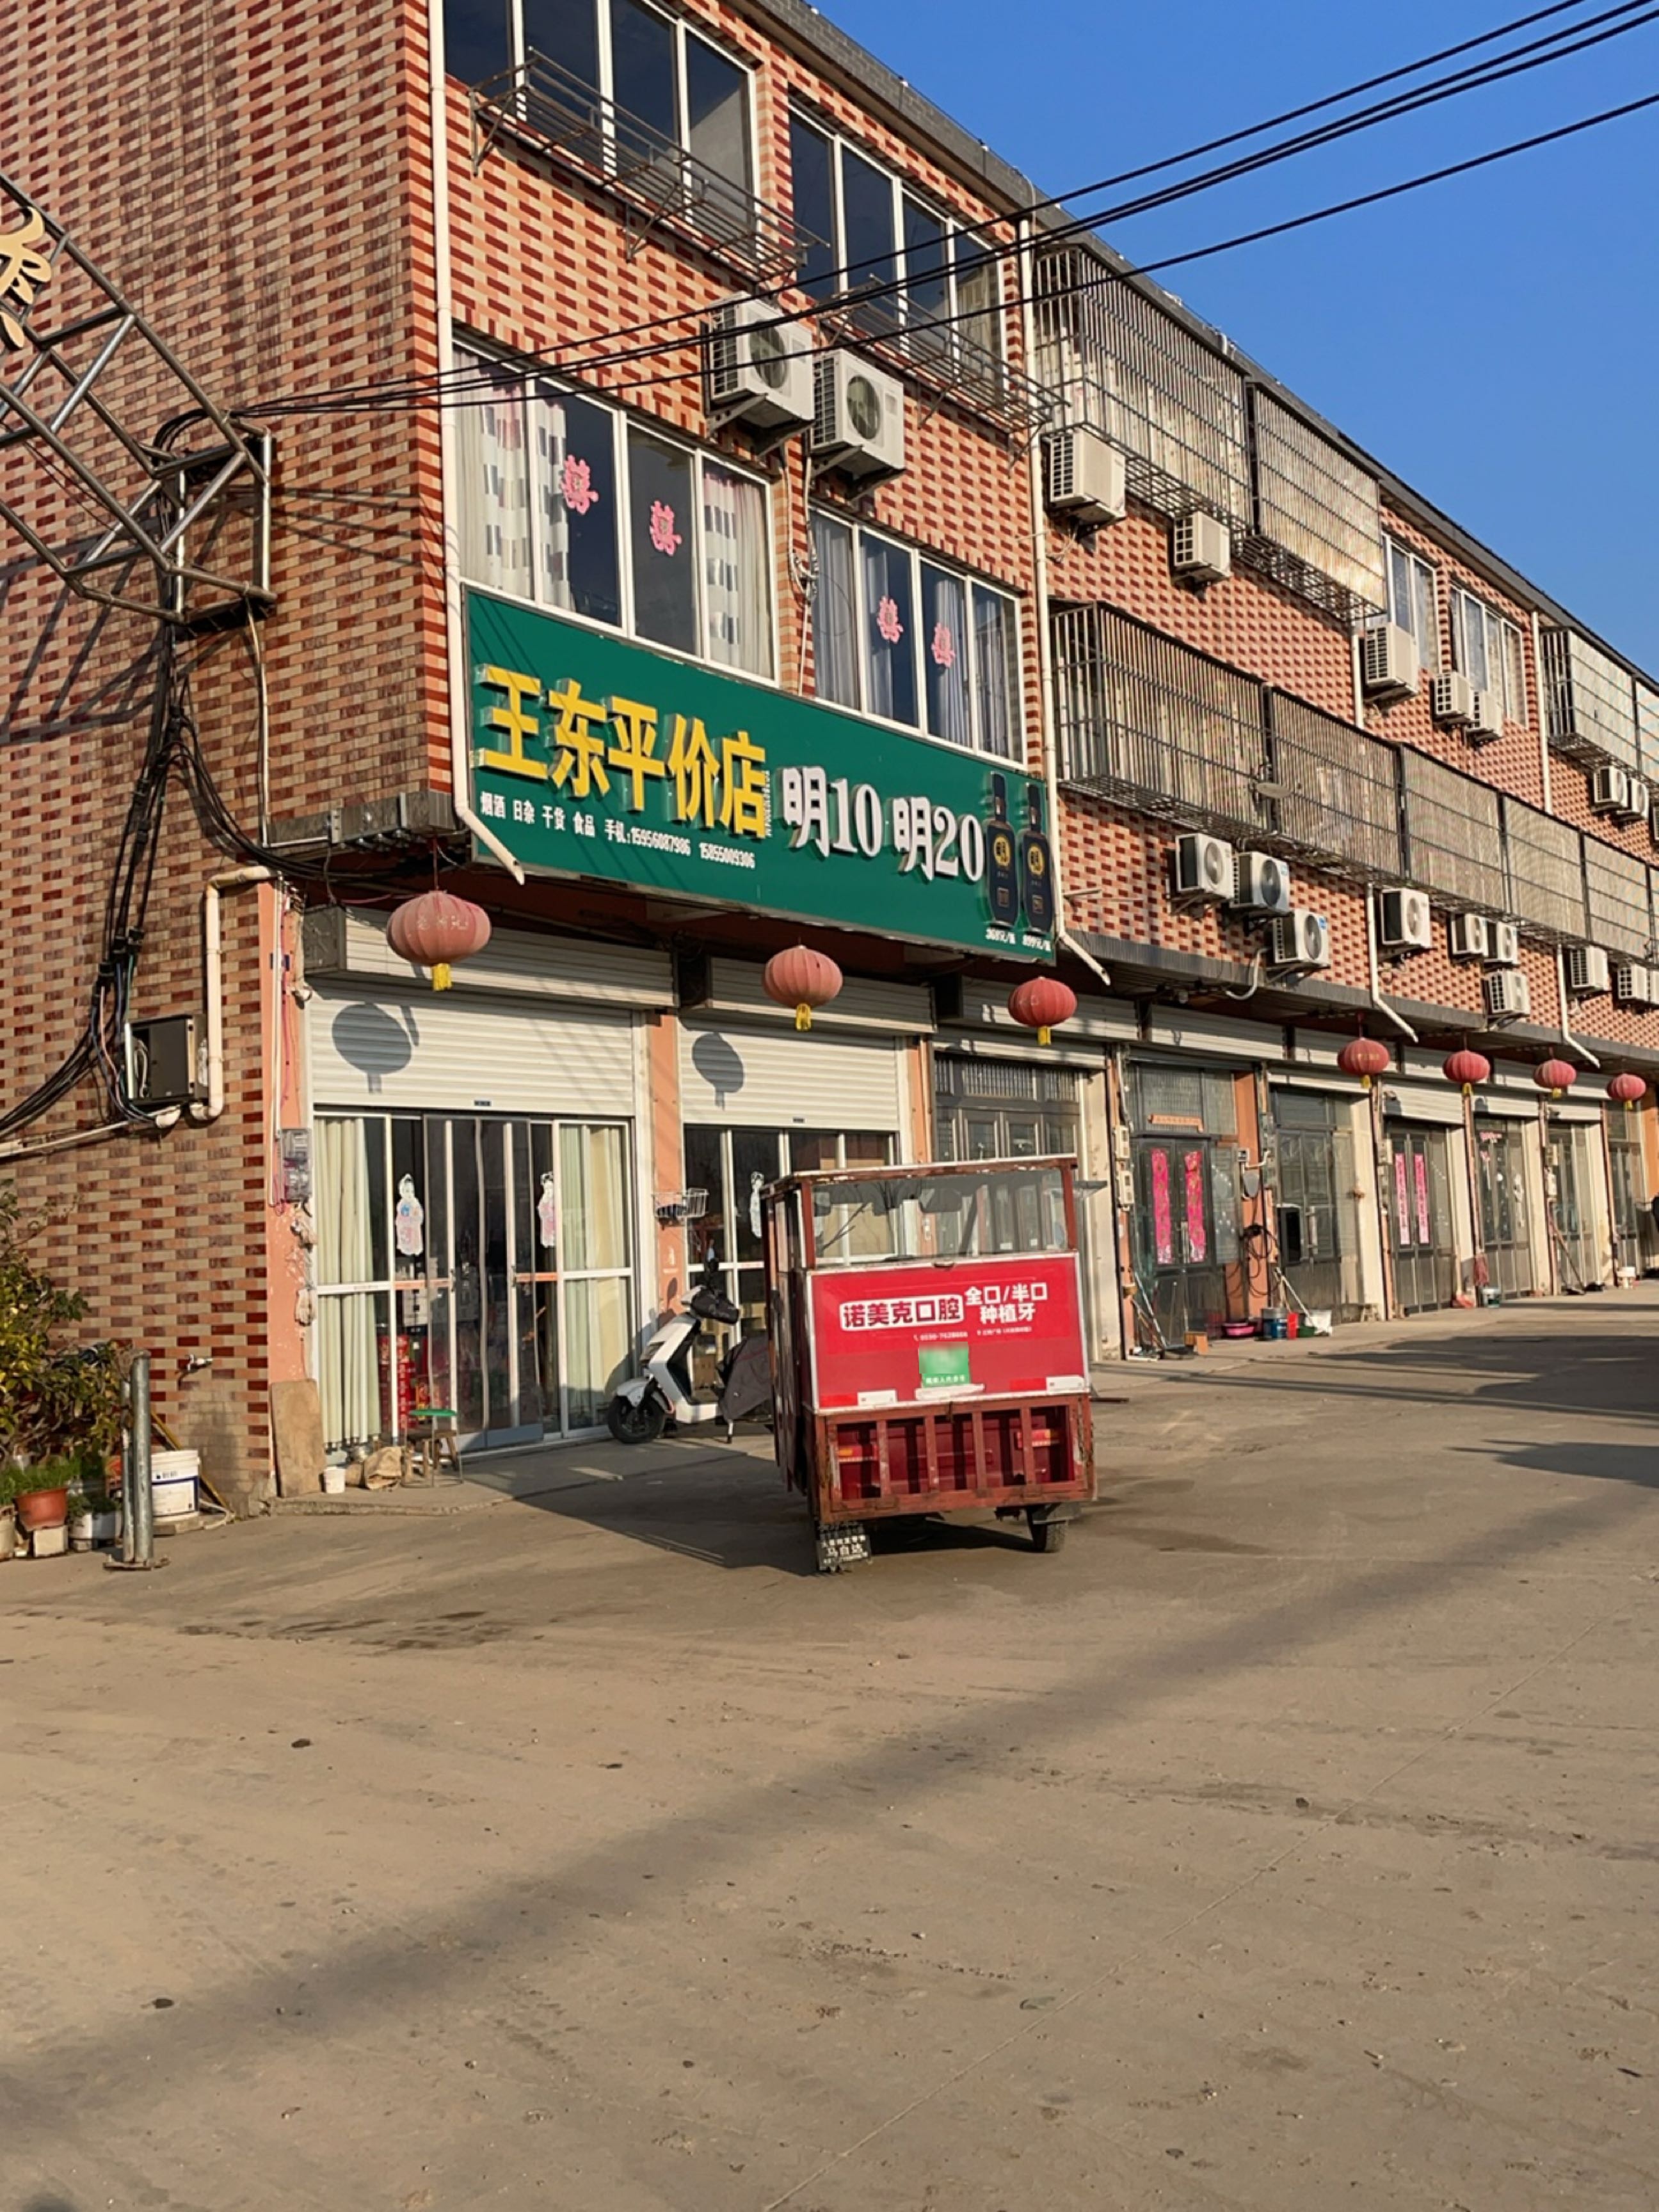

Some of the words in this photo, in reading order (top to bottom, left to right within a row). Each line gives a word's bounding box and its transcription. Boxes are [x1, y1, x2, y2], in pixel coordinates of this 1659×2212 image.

[476, 664, 766, 839] 王东平价店
[480, 790, 506, 819] 烟酒
[512, 799, 535, 824] 日杂
[541, 805, 566, 831] 干货
[573, 811, 595, 837] 食品
[783, 766, 883, 857] 明10
[892, 797, 984, 881] 明20
[843, 1298, 961, 1328] 诺美克口腔
[965, 1282, 1048, 1306] 全口/半口
[980, 1302, 1036, 1325] 种植牙
